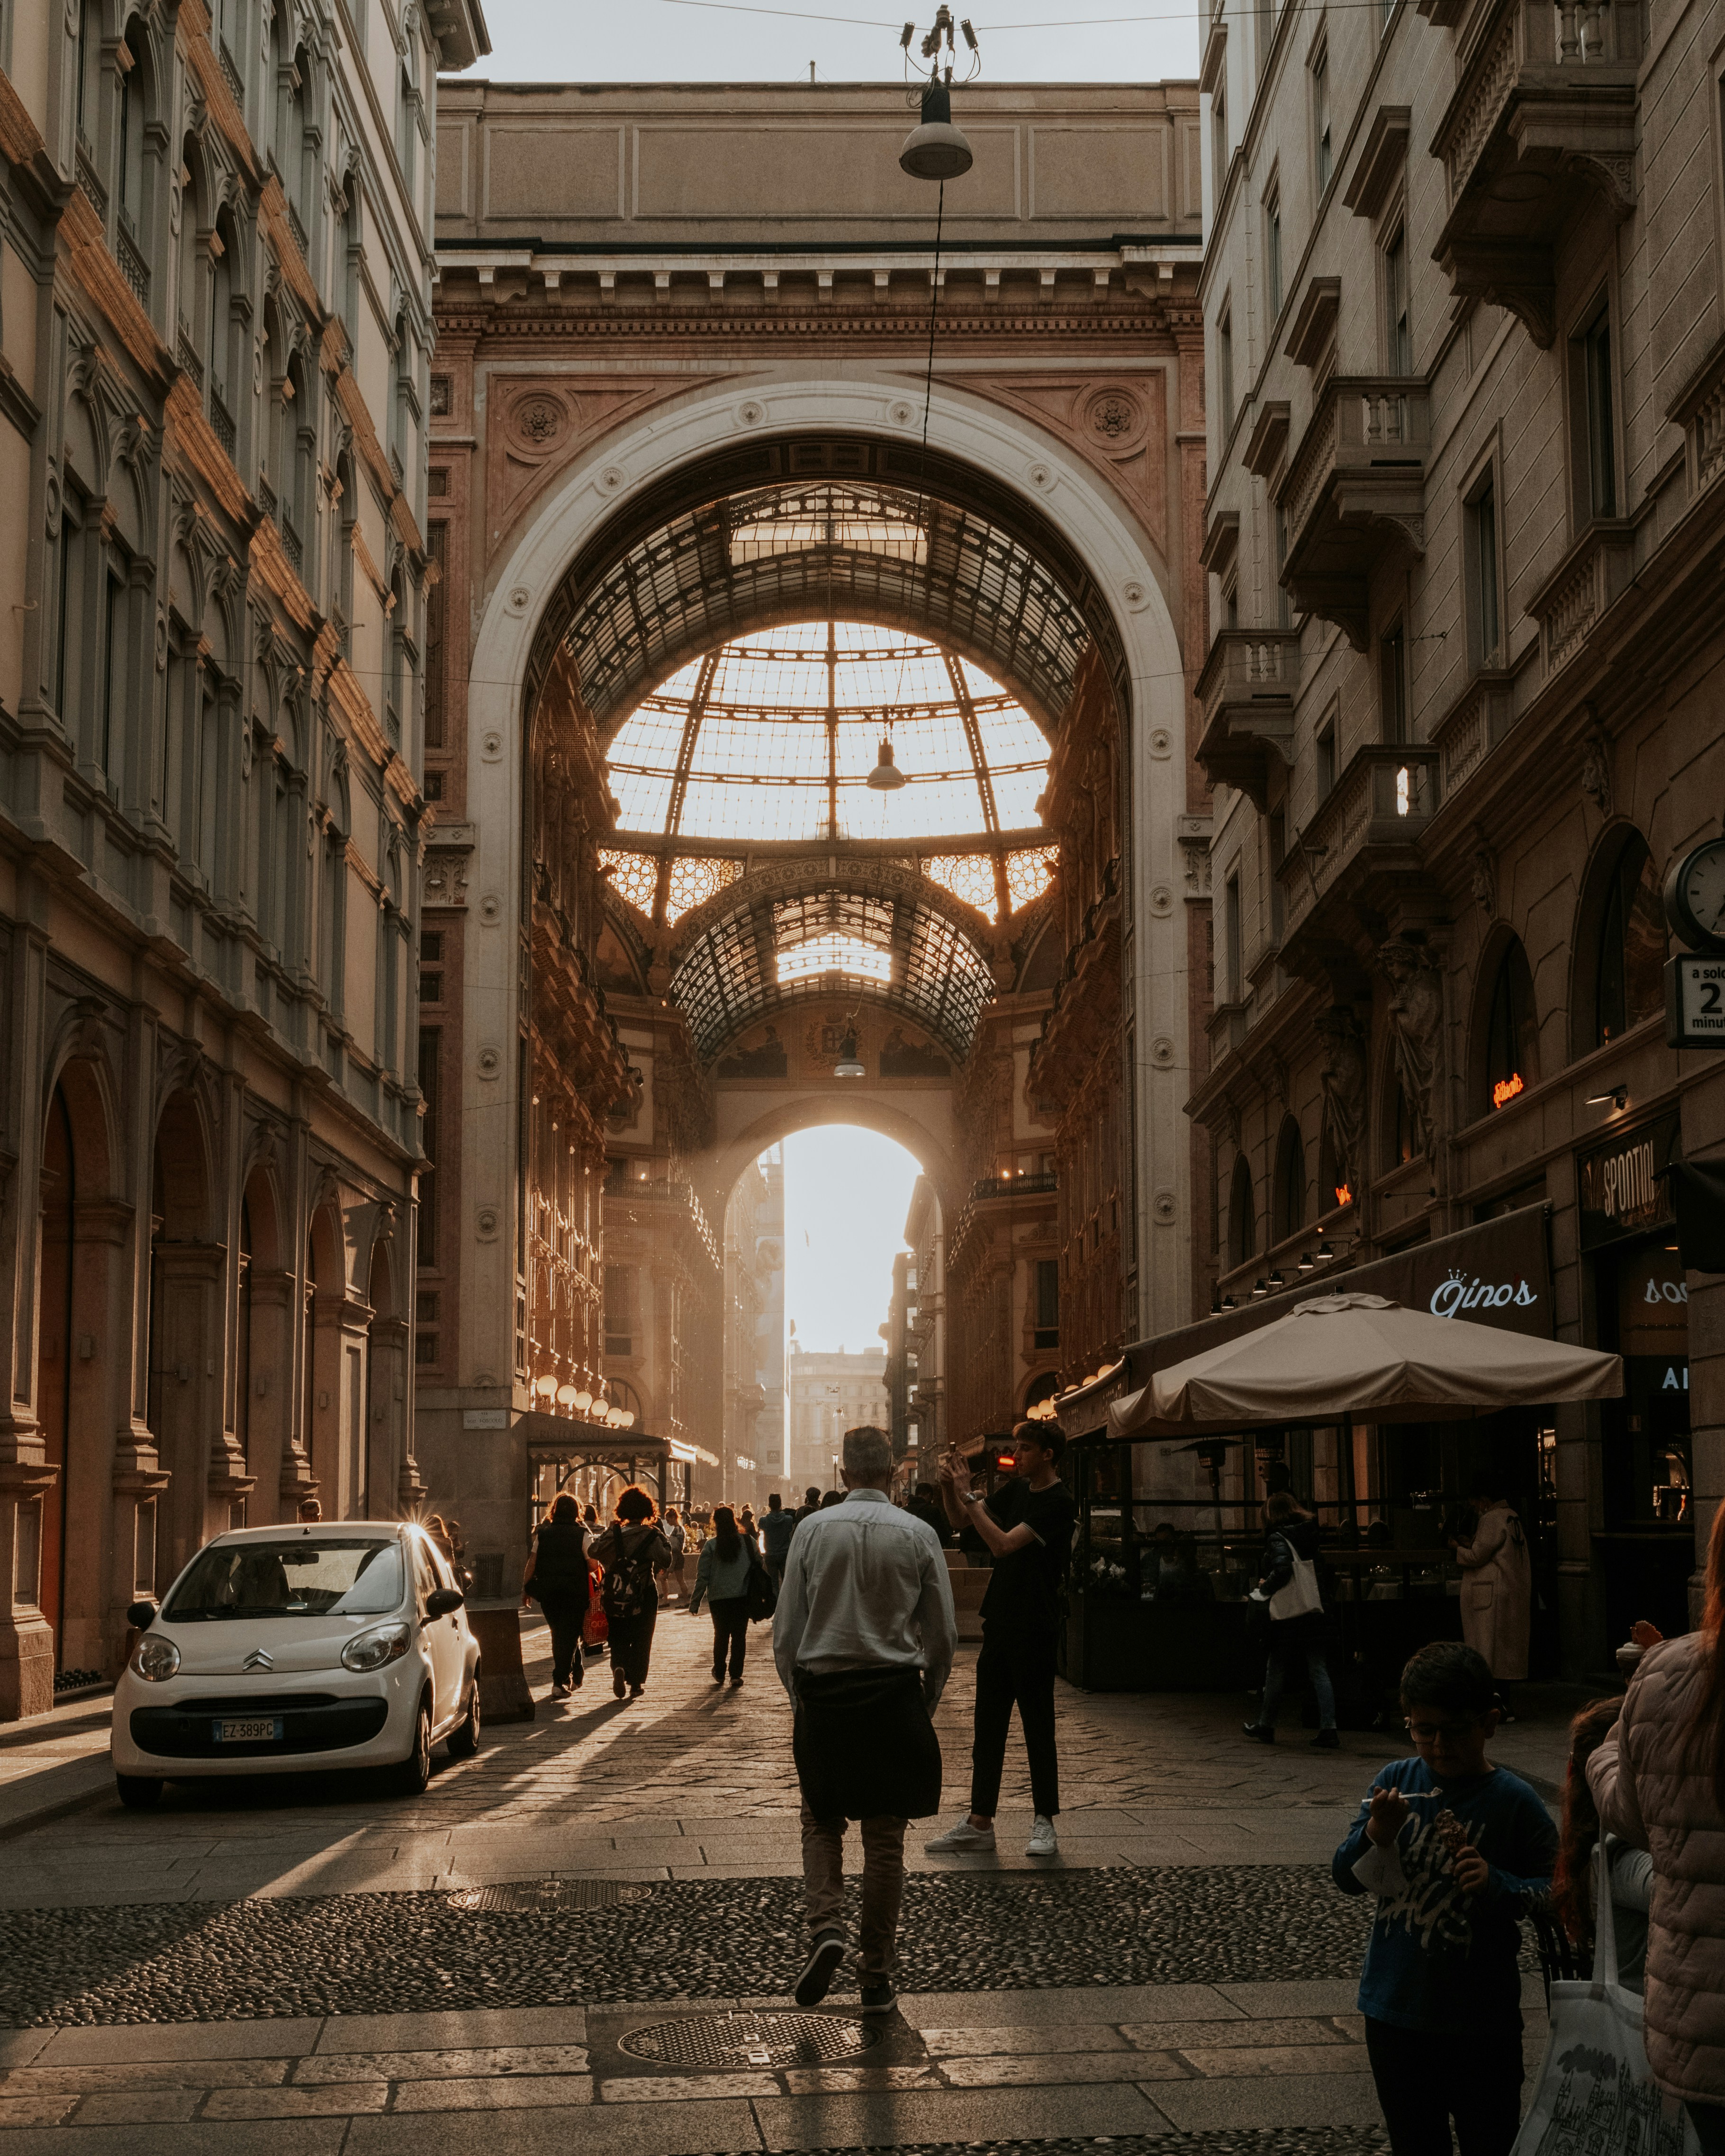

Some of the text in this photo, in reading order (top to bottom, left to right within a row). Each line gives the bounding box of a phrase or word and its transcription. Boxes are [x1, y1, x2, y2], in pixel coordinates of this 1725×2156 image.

[1693, 969, 1699, 978] a
[1701, 983, 1723, 1013] 2
[1604, 1139, 1655, 1218] SPONTINI
[540, 1430, 608, 1439] RISTORANTE
[223, 1723, 273, 1738] EZ 389PG
